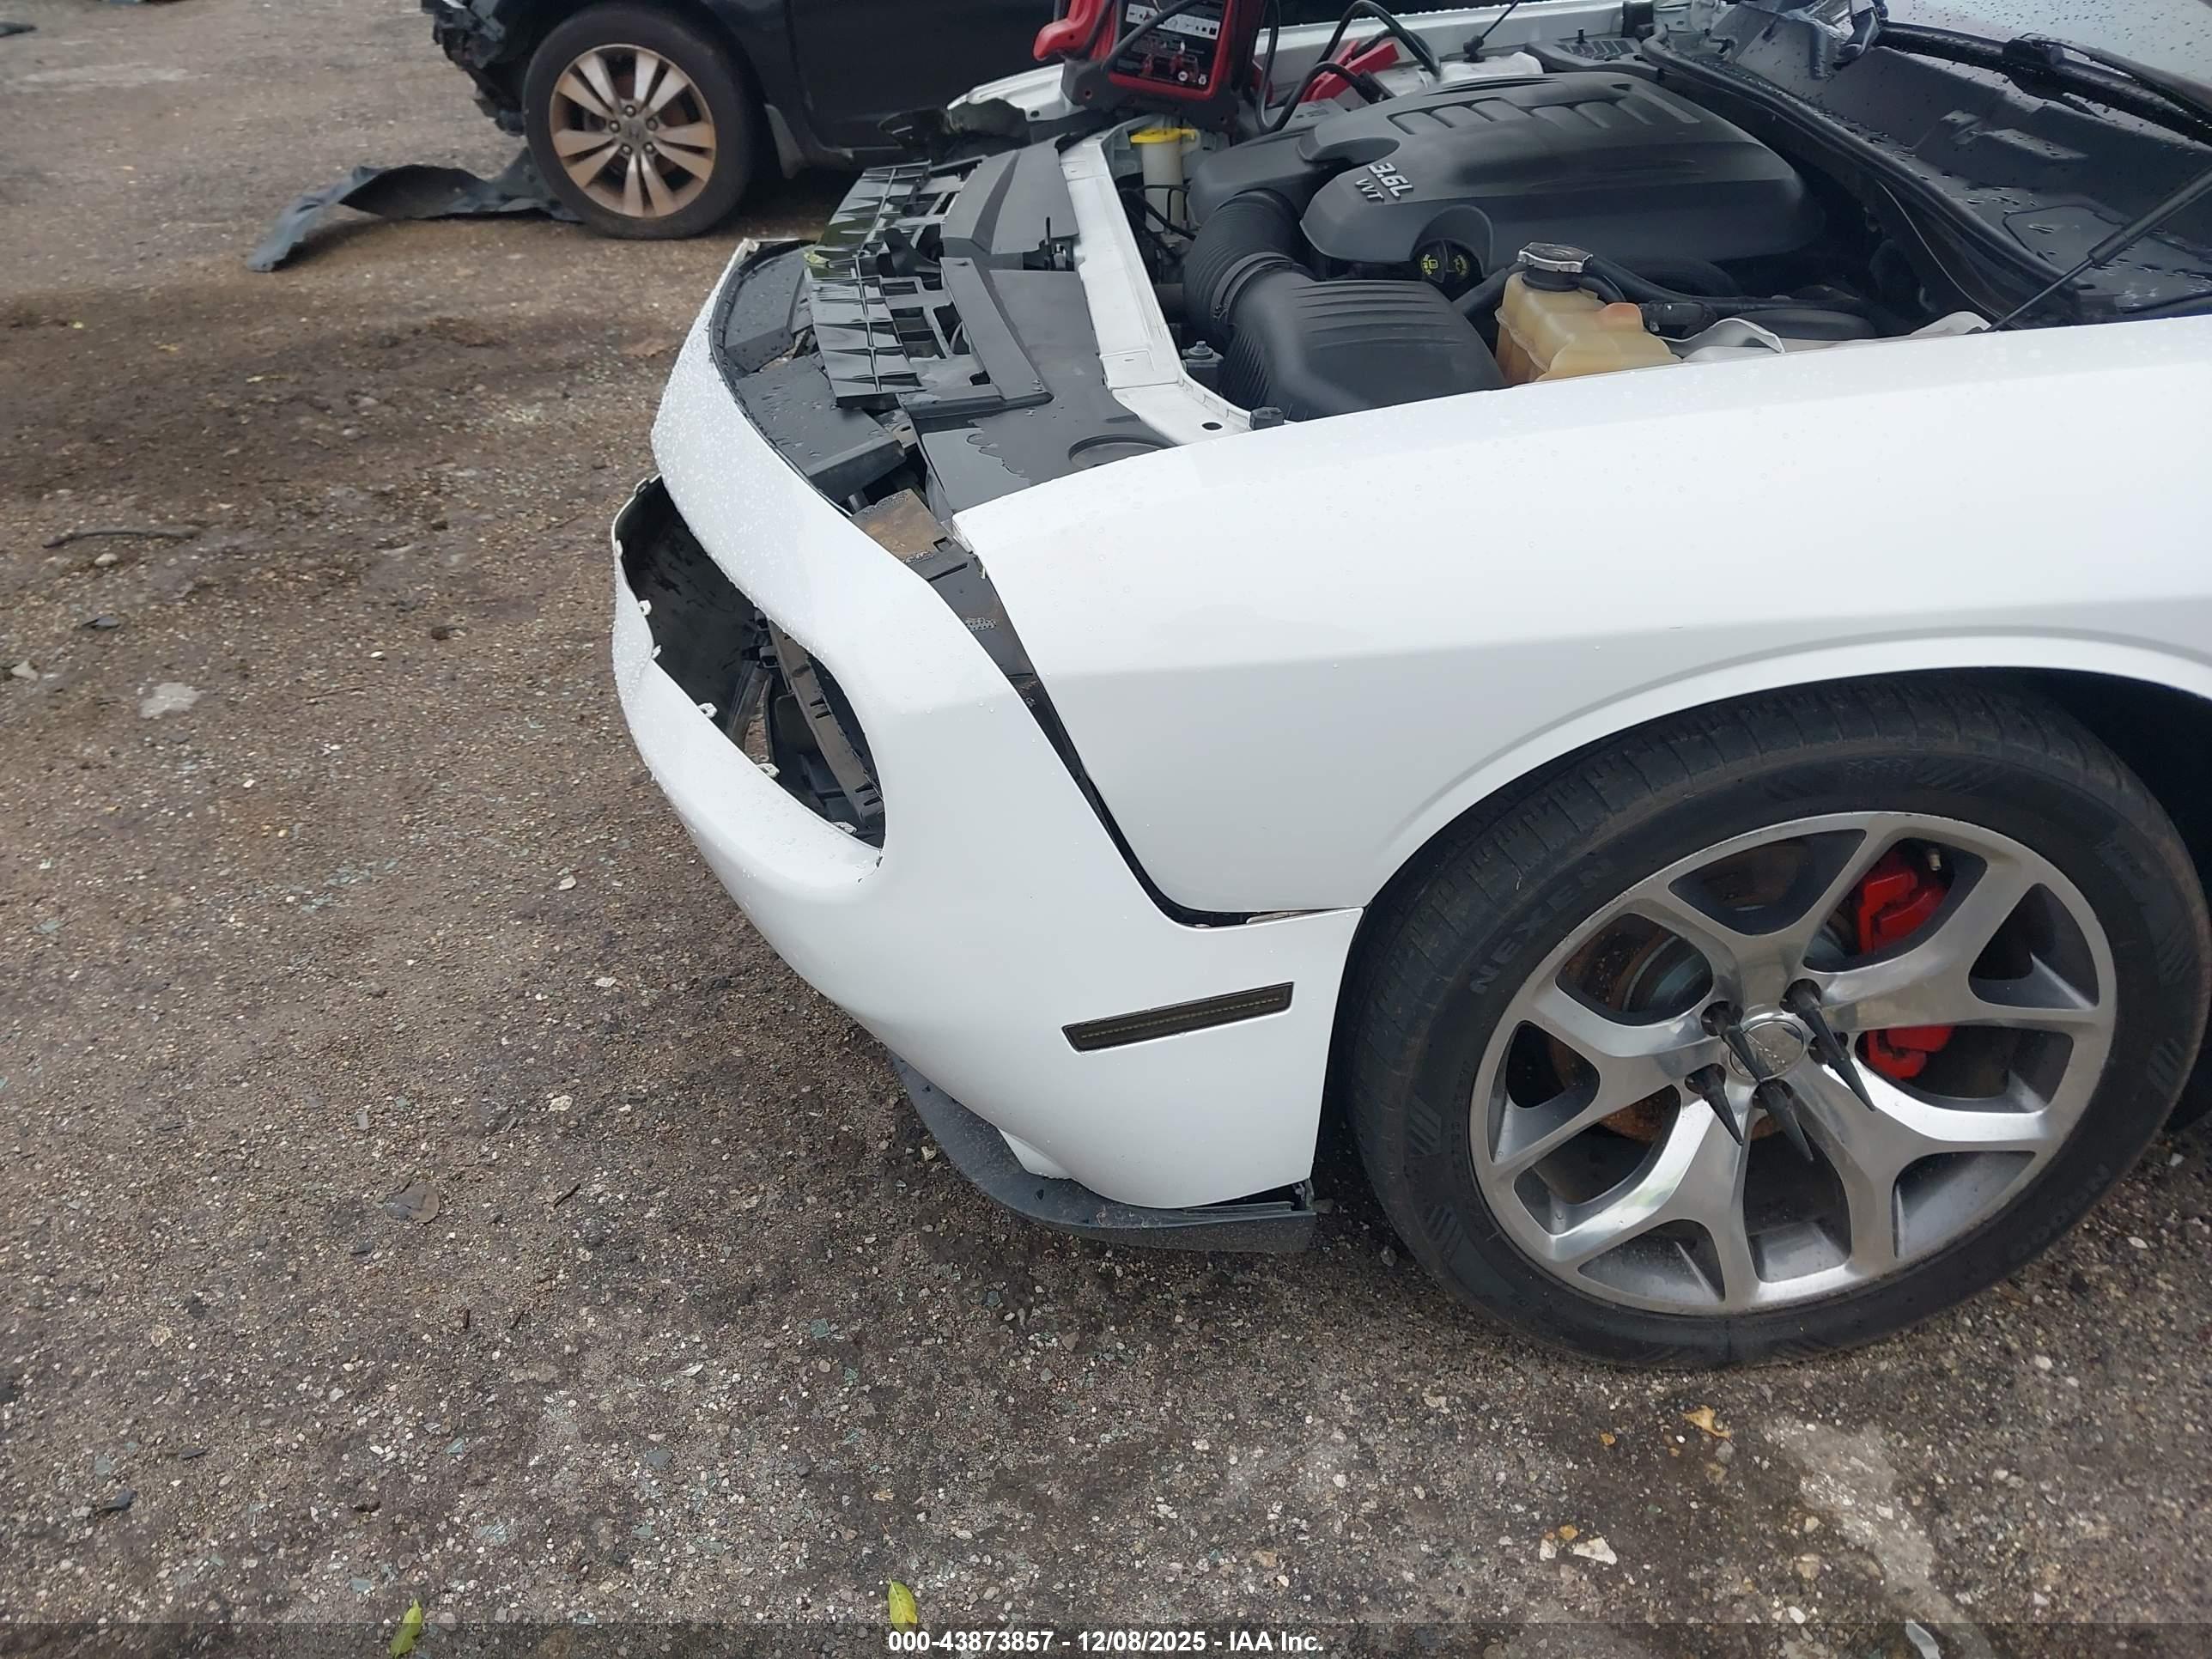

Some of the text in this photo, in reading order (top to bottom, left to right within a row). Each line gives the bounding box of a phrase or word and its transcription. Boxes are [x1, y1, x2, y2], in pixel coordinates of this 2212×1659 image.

[1355, 178, 1384, 199] VVT
[1368, 162, 1413, 198] 3.6L
[1469, 857, 1619, 994] NEXEN
